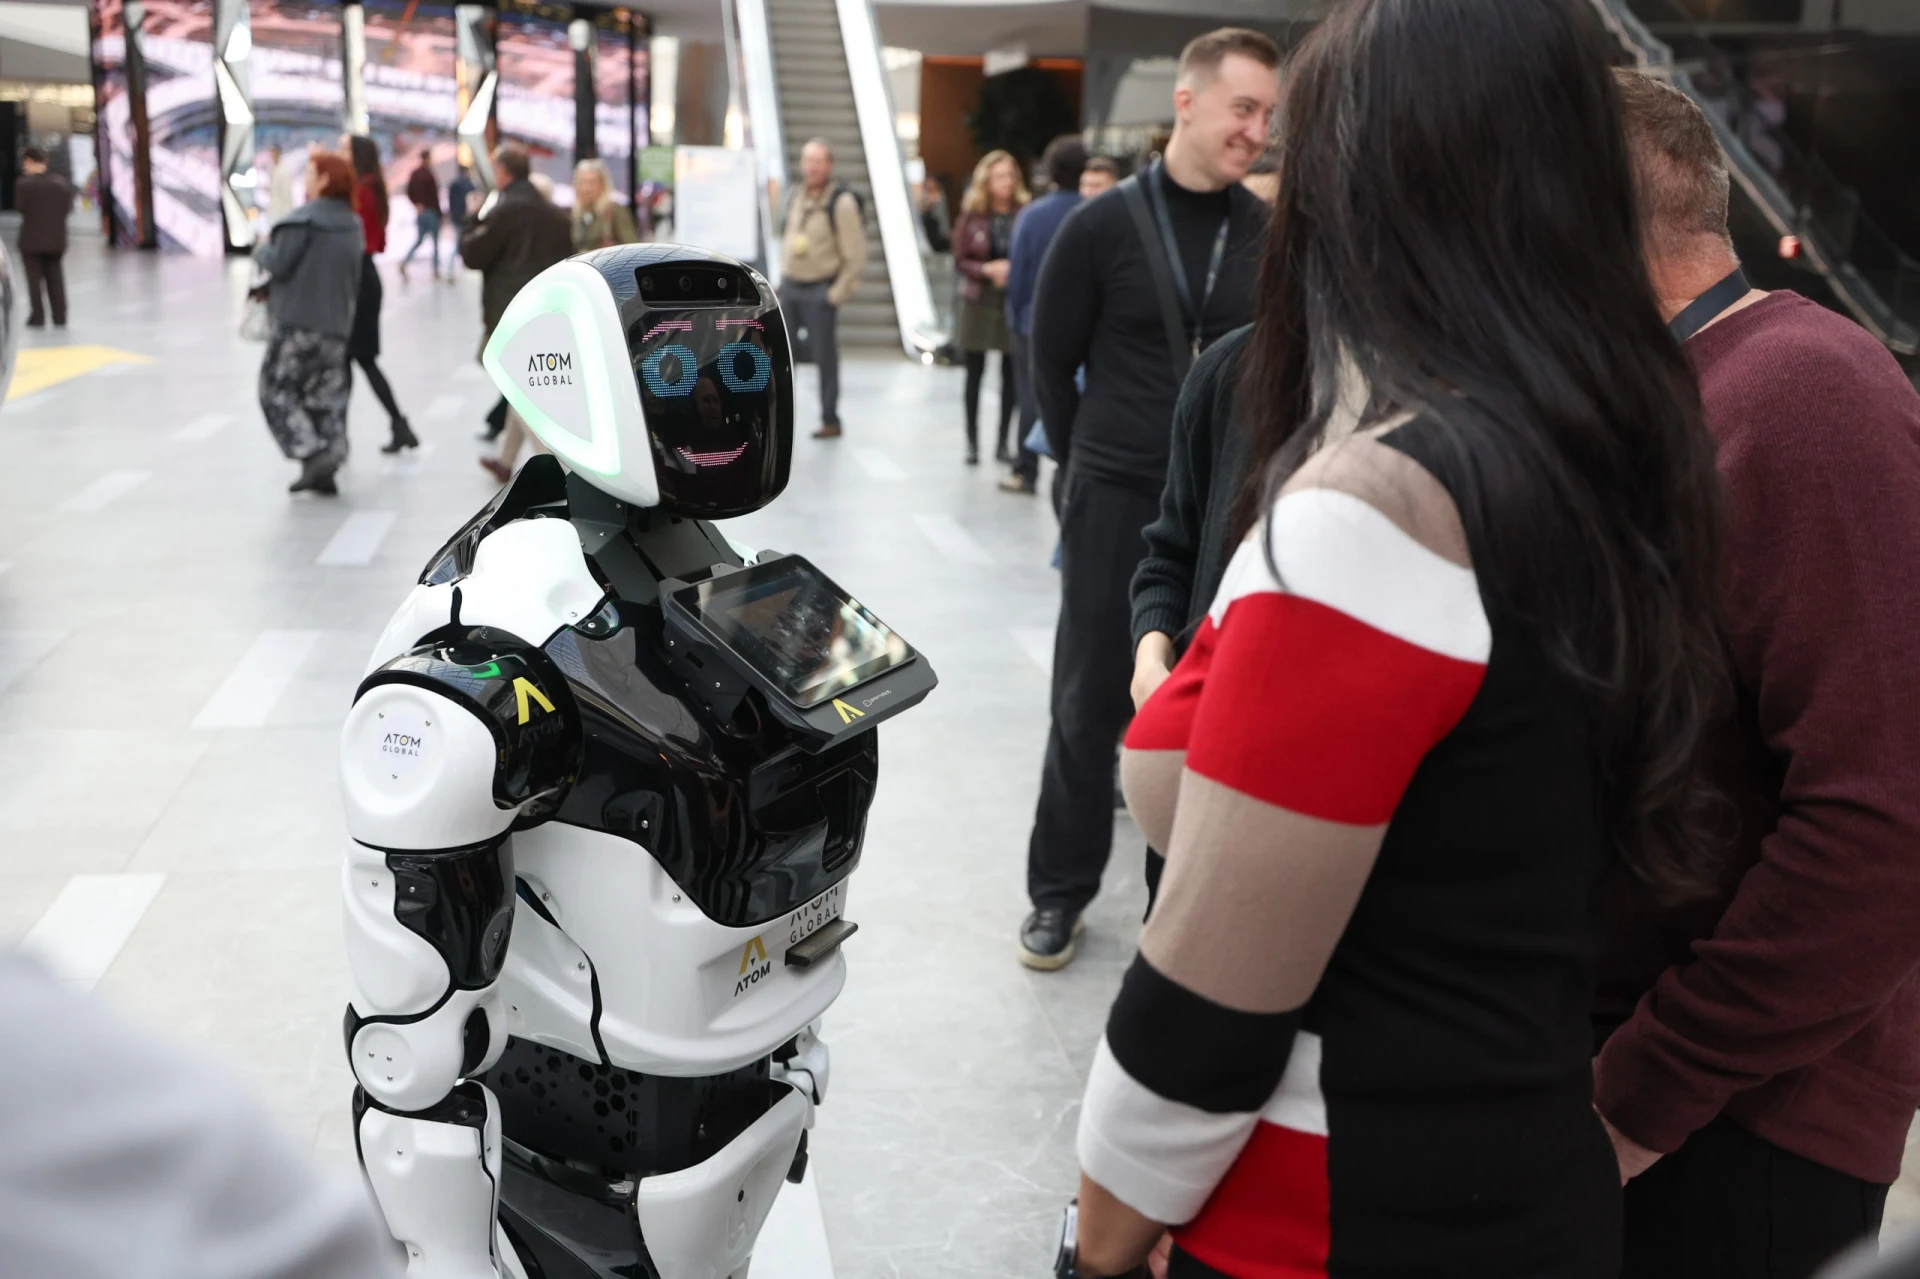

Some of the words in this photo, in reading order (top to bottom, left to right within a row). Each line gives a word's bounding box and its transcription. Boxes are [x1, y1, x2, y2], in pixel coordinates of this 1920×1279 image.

[528, 352, 572, 372] ATOM
[528, 374, 572, 387] GLOBAL
[384, 733, 421, 748] ATOM
[382, 744, 419, 757] GLOBAL
[790, 903, 838, 944] GLOBAL
[734, 961, 771, 998] ATOM
